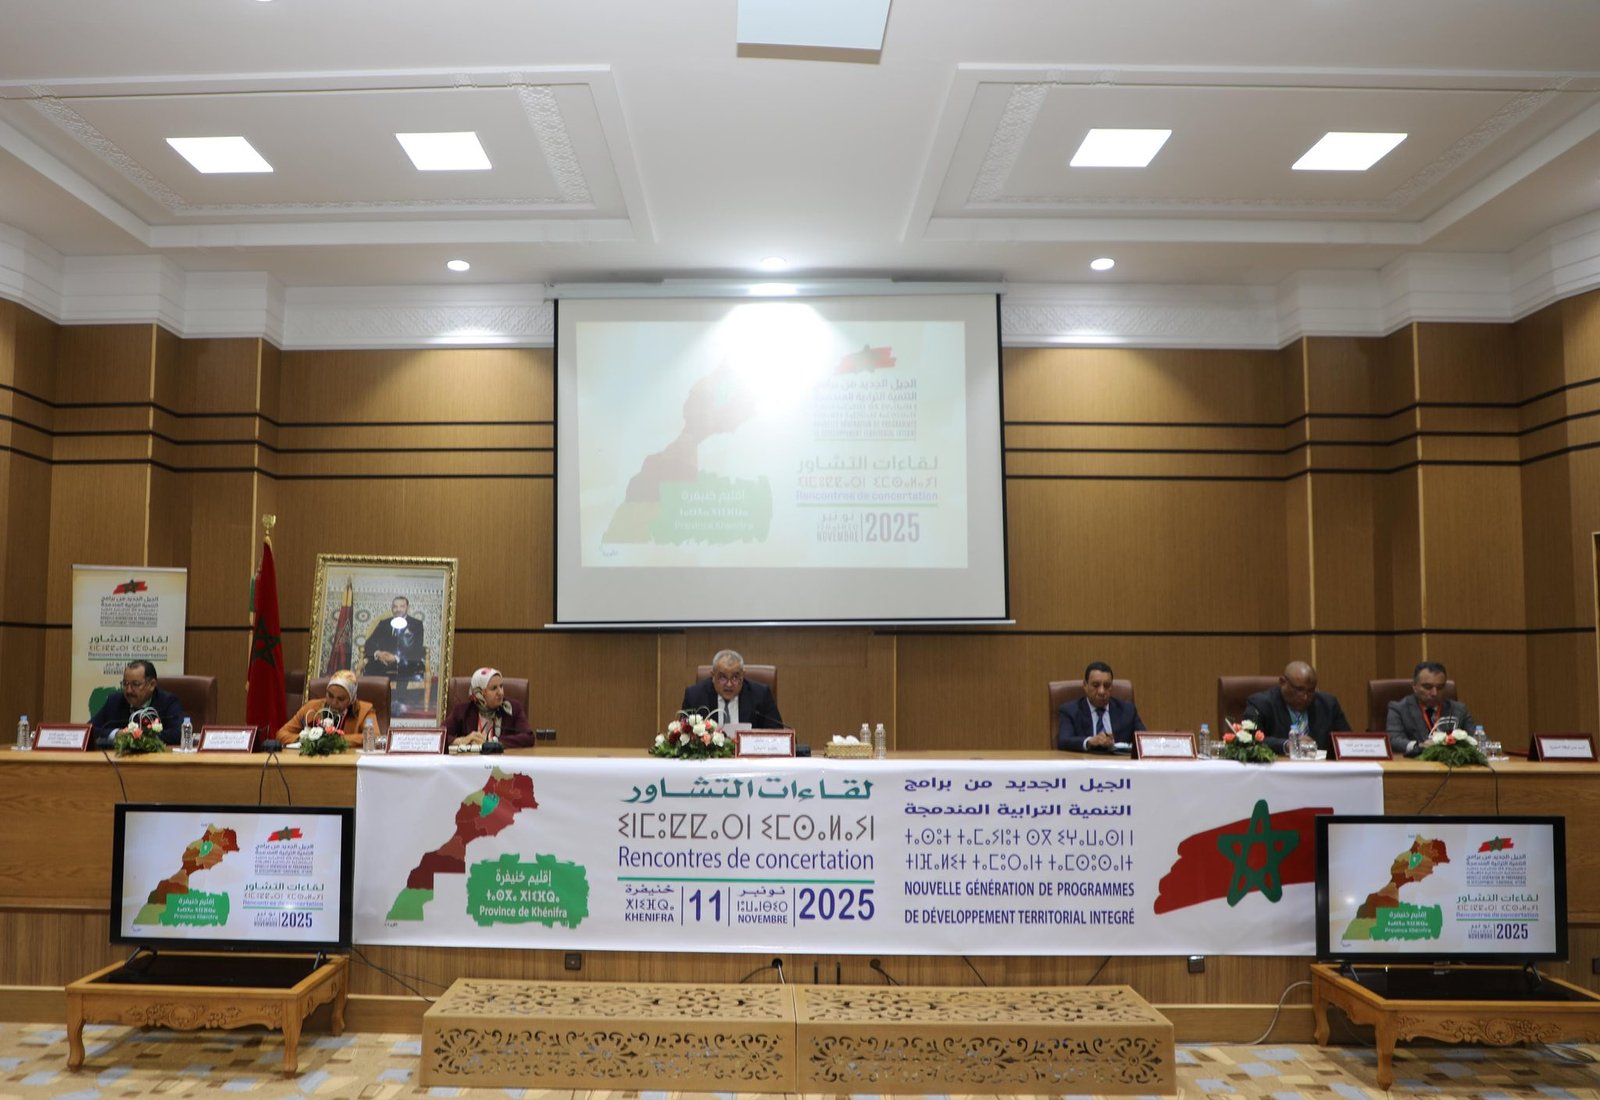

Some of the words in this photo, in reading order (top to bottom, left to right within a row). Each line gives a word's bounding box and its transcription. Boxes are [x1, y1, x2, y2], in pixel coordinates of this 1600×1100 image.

[872, 455, 938, 471] لقاءات
[864, 512, 921, 543] 2025
[619, 776, 754, 804] التشاور
[758, 777, 874, 802] لقاءات
[904, 777, 952, 792] برامج
[964, 779, 993, 791] من
[1005, 777, 1067, 792] الجديد
[1080, 778, 1131, 792] الجيل
[904, 802, 990, 818] المندمجة
[997, 803, 1061, 819] الترابية
[1068, 803, 1132, 819] التنمية
[618, 845, 722, 868] Rencontres
[727, 846, 751, 869] de
[755, 848, 875, 871] concertation
[495, 868, 526, 887] خنيفرة
[527, 869, 552, 887] إقليم
[625, 883, 675, 896] خنيفرة
[904, 881, 962, 896] NOUVELLE
[965, 879, 1035, 897] GÉNÉRATION
[1039, 882, 1053, 897] DE
[1057, 882, 1135, 897] PROGRAMMES
[688, 888, 721, 922] 11
[798, 887, 875, 920] 2025
[281, 911, 313, 928] 2025
[479, 905, 516, 917] Province
[518, 905, 530, 917] de
[531, 906, 567, 919] Khénifra
[625, 912, 675, 922] KHENIFRA
[737, 914, 788, 924] NOVEMBRE
[905, 909, 919, 924] DE
[922, 906, 1016, 924] DÉVELOPPEMENT
[1018, 910, 1087, 925] TERRITORIAL
[1089, 907, 1135, 925] INTEGRÉ
[1496, 923, 1529, 940] 2025
